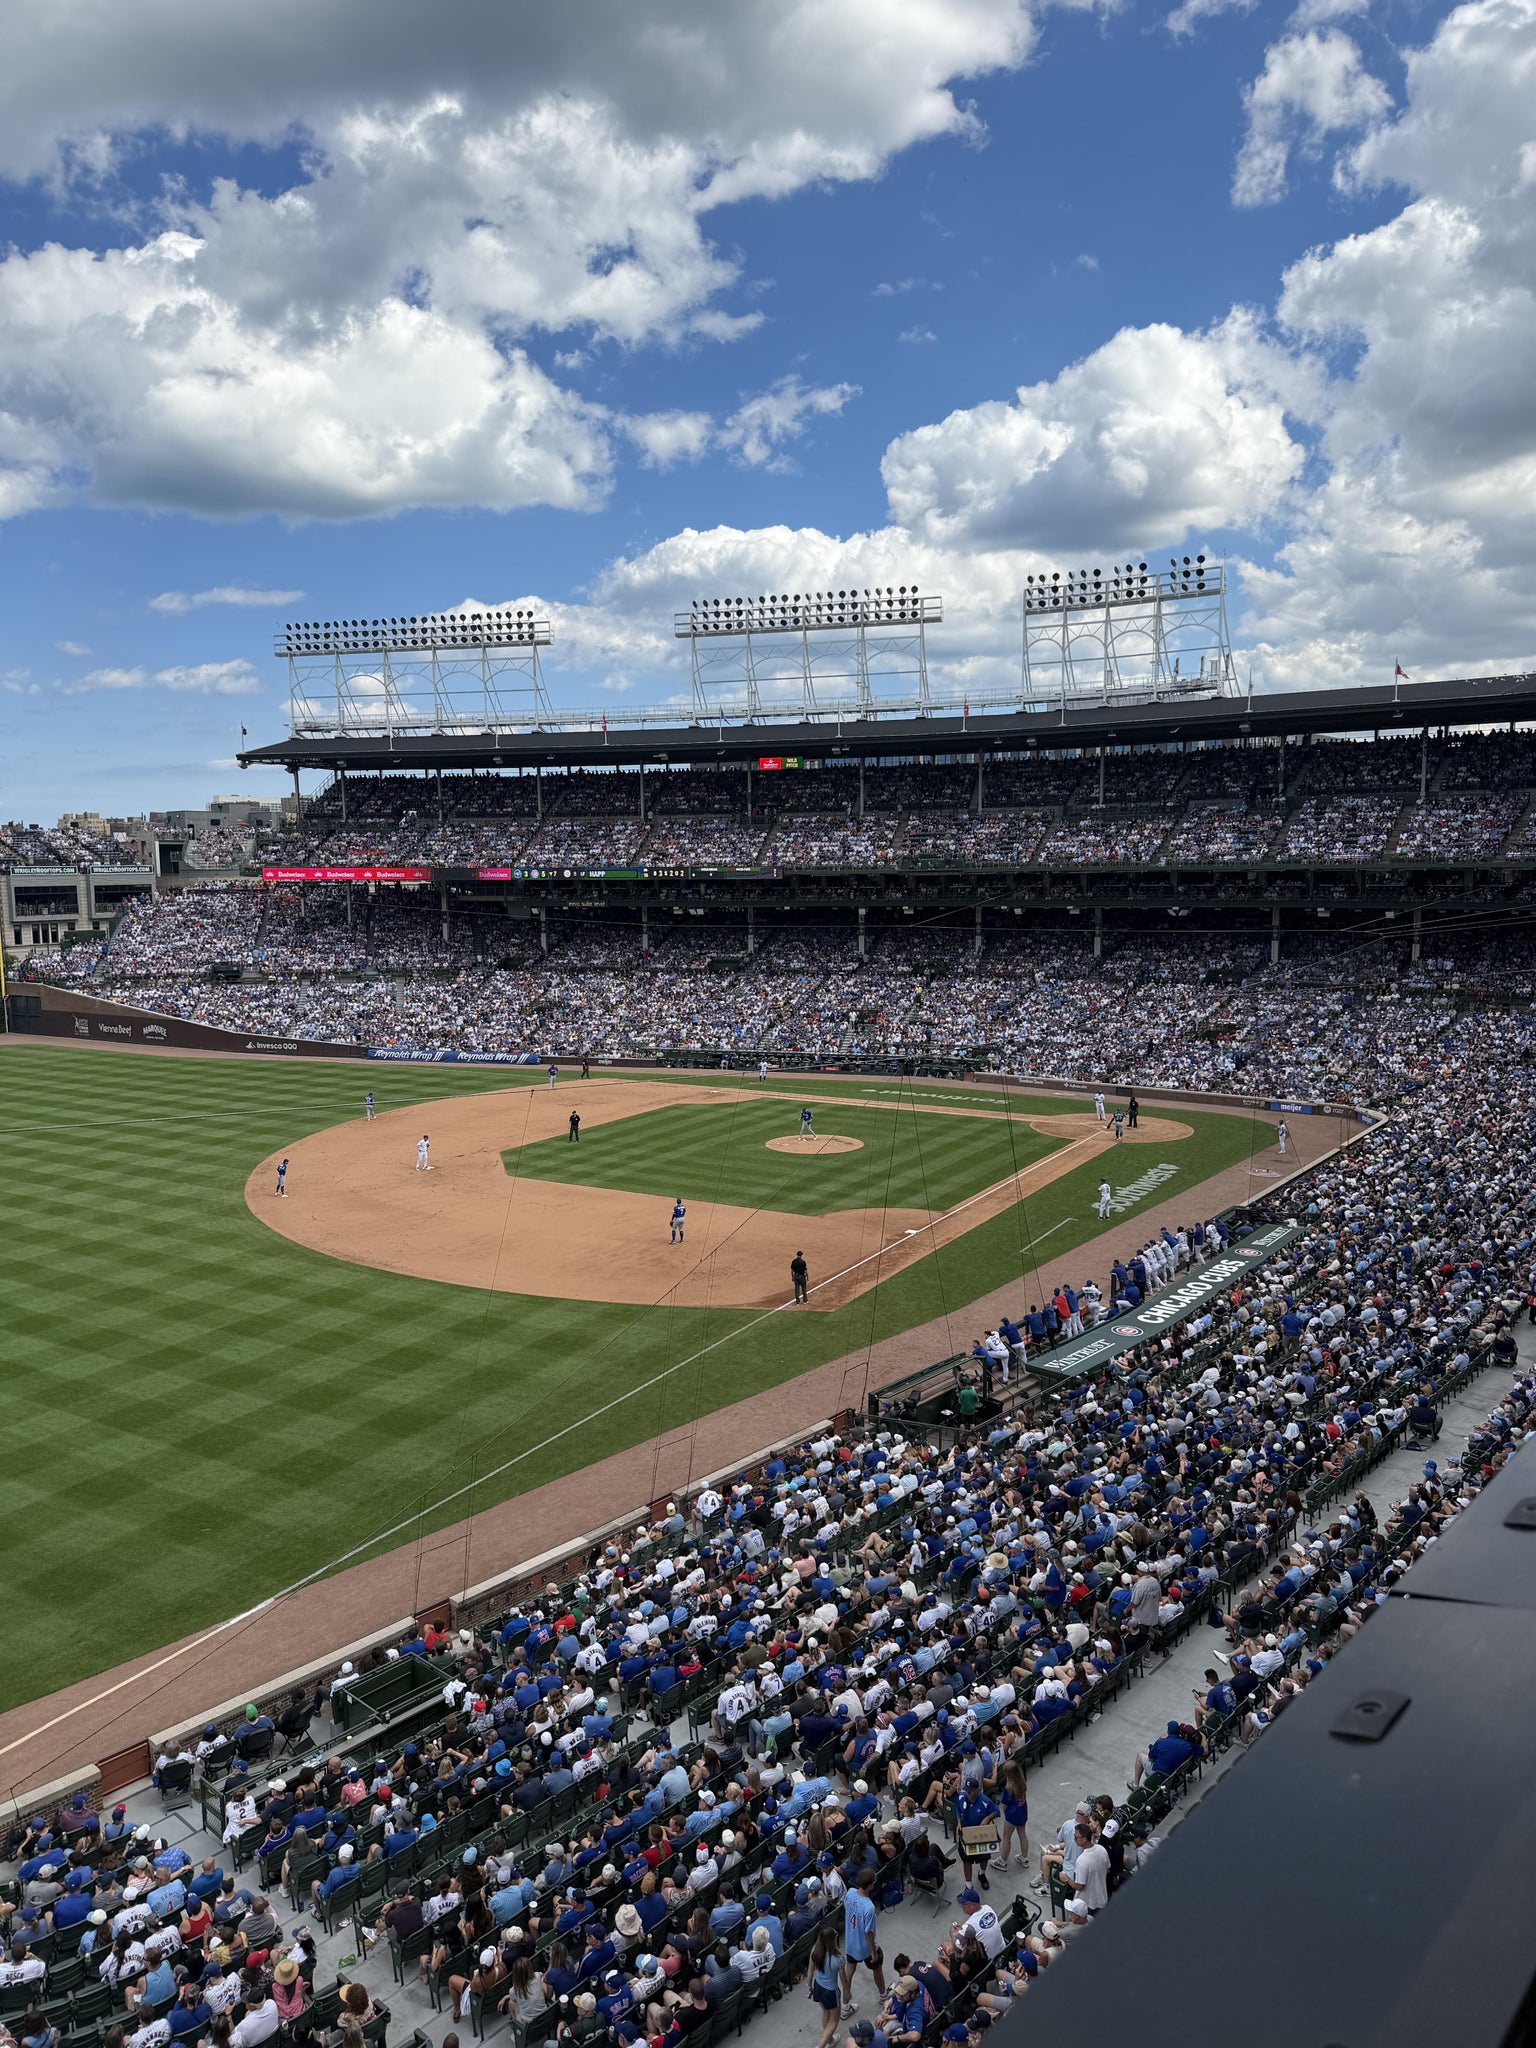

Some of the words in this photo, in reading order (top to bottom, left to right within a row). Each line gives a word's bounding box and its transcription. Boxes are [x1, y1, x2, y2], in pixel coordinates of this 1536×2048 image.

[98, 1022, 118, 1034] Vienna
[118, 1024, 132, 1037] Beef
[142, 1024, 167, 1037] MARQUEE
[257, 1042, 283, 1050] Invesco
[374, 1050, 411, 1060] Reynolds
[411, 1051, 433, 1061] Wrap
[457, 1052, 494, 1061] Reynolds
[494, 1053, 518, 1062] Wrap
[1280, 1103, 1302, 1113] meijer
[1136, 1274, 1213, 1324] CHICAGO
[1044, 1338, 1113, 1370] WINTRUST
[711, 1498, 717, 1508] 4
[984, 1616, 996, 1626] 40
[596, 1656, 603, 1668] 4
[903, 1665, 916, 1681] 12
[775, 1679, 781, 1690] 7
[737, 1699, 745, 1712] 4
[239, 1808, 248, 1820] 2
[850, 1914, 857, 1930] 4
[157, 1936, 174, 1950] SOSA
[752, 1953, 772, 1968] KALINE
[6, 1972, 25, 1981] BUSCH
